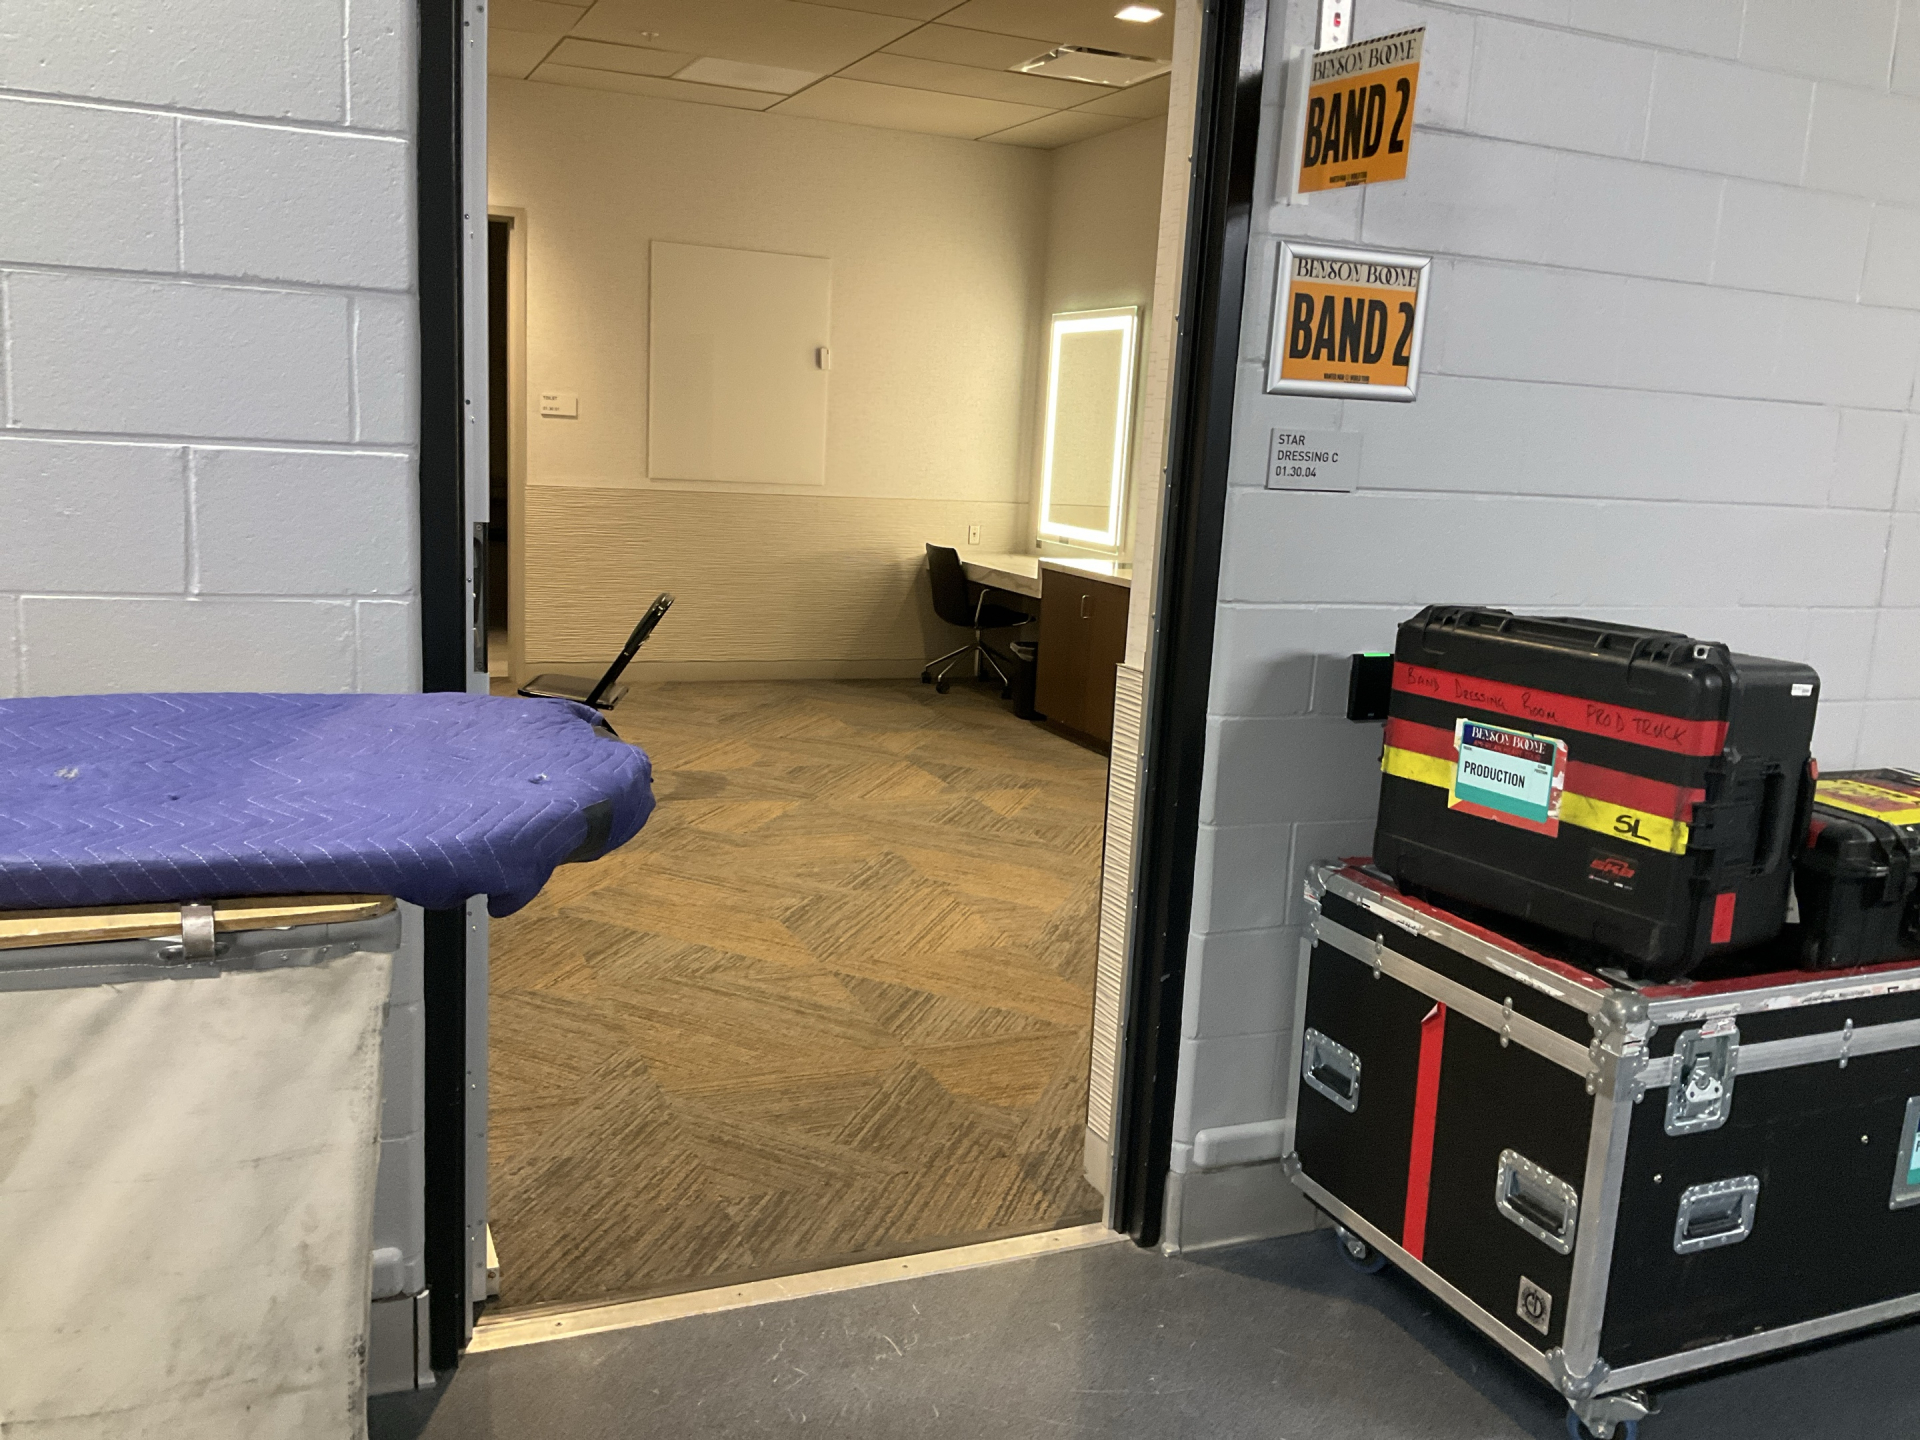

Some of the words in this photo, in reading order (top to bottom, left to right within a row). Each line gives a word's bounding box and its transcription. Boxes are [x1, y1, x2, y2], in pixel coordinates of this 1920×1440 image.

[1312, 50, 1366, 81] BENSON
[1368, 38, 1417, 68] BOONE
[1303, 83, 1387, 168] BAND
[1388, 77, 1411, 154] 2
[1296, 257, 1362, 282] BENSON
[1366, 264, 1418, 287] BOONE
[1289, 292, 1388, 365] BAND
[1392, 301, 1414, 366] 2
[1278, 433, 1306, 446] STAR
[1277, 449, 1329, 463] DRESSING
[1331, 452, 1339, 463] C
[1275, 465, 1317, 478] 01.30.04
[1586, 703, 1626, 733] PROD
[1633, 718, 1687, 745] TRUCK
[1471, 726, 1511, 746] BENSON
[1512, 736, 1547, 755] BOONE
[1463, 760, 1526, 789] PRODUCTION
